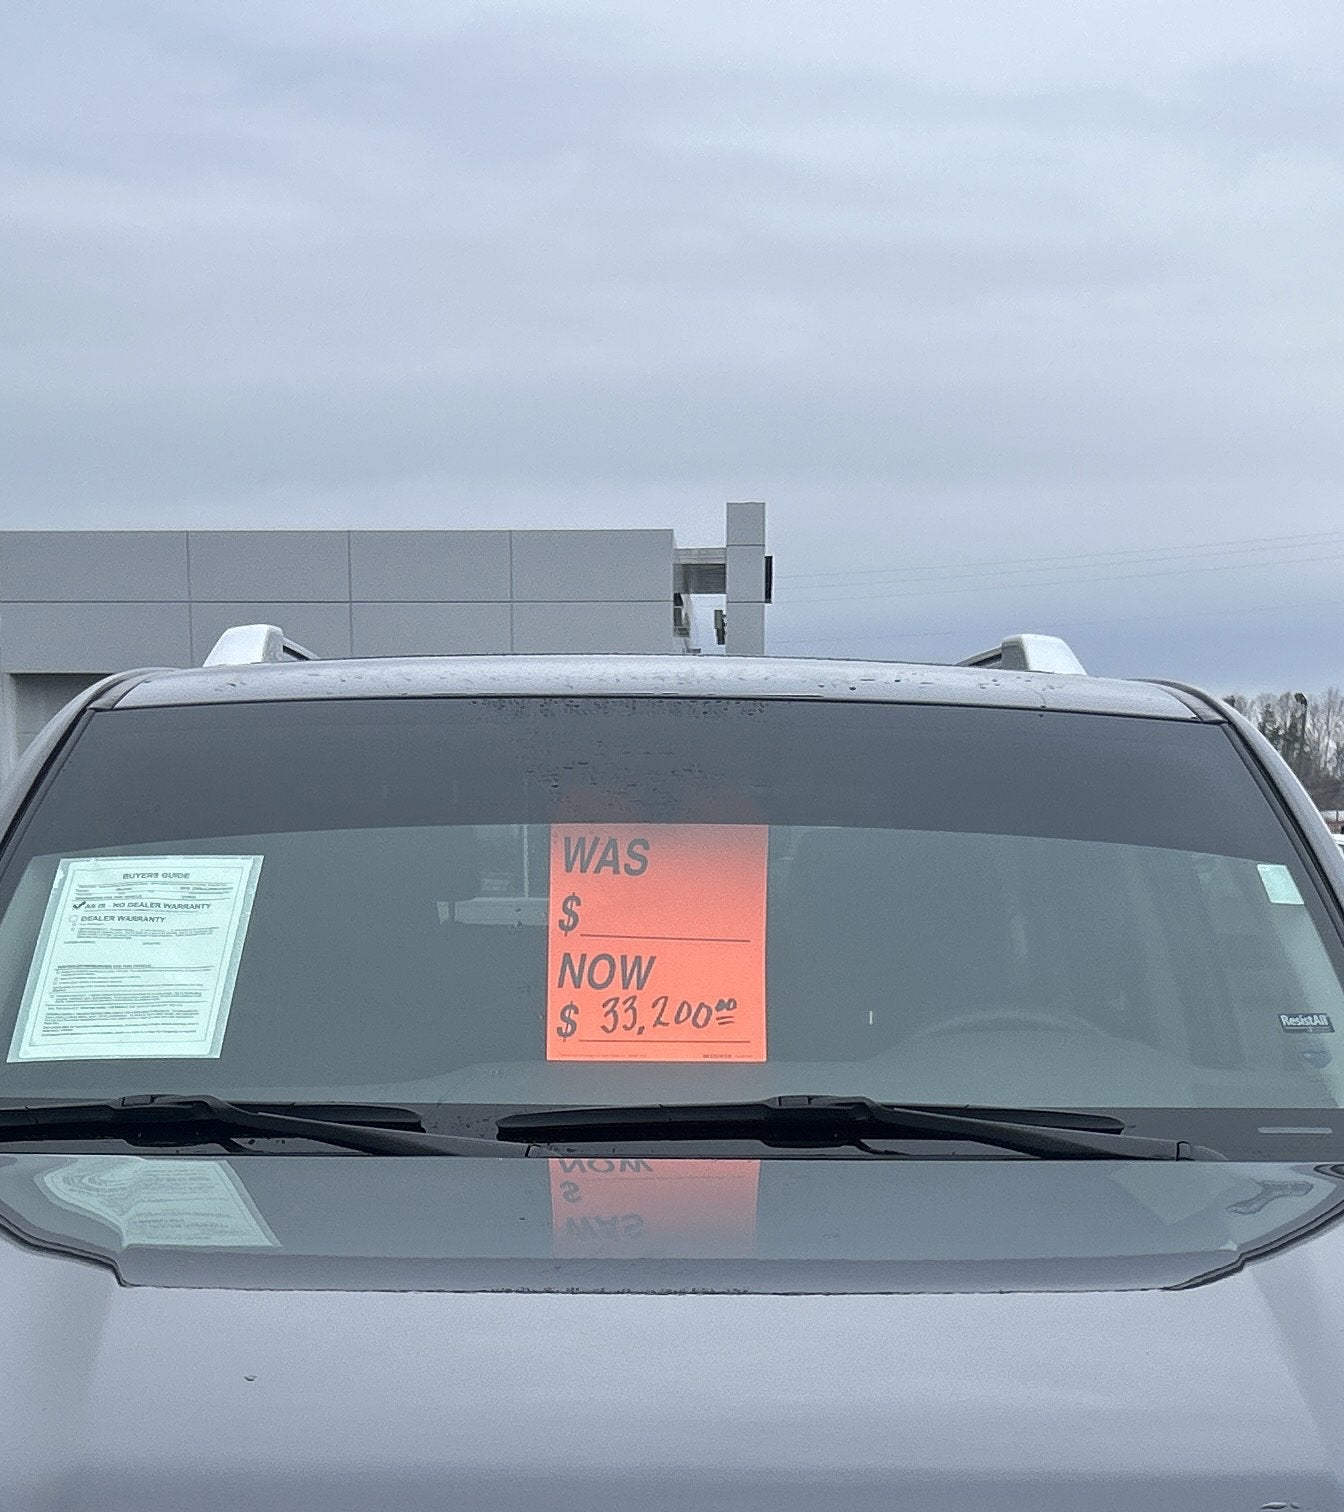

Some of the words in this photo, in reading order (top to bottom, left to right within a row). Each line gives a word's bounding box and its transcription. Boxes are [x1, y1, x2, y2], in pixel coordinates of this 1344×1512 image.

[563, 836, 651, 877] WAS
[122, 872, 159, 880] BUYERS
[161, 871, 190, 880] GUIDE
[127, 901, 162, 909] DEALER
[163, 902, 212, 910] WARRANTY
[558, 892, 582, 936] $
[117, 915, 166, 923] WARRANTY
[557, 952, 657, 991] NOW
[556, 1001, 580, 1042] $
[1280, 1014, 1329, 1026] ResistAll
